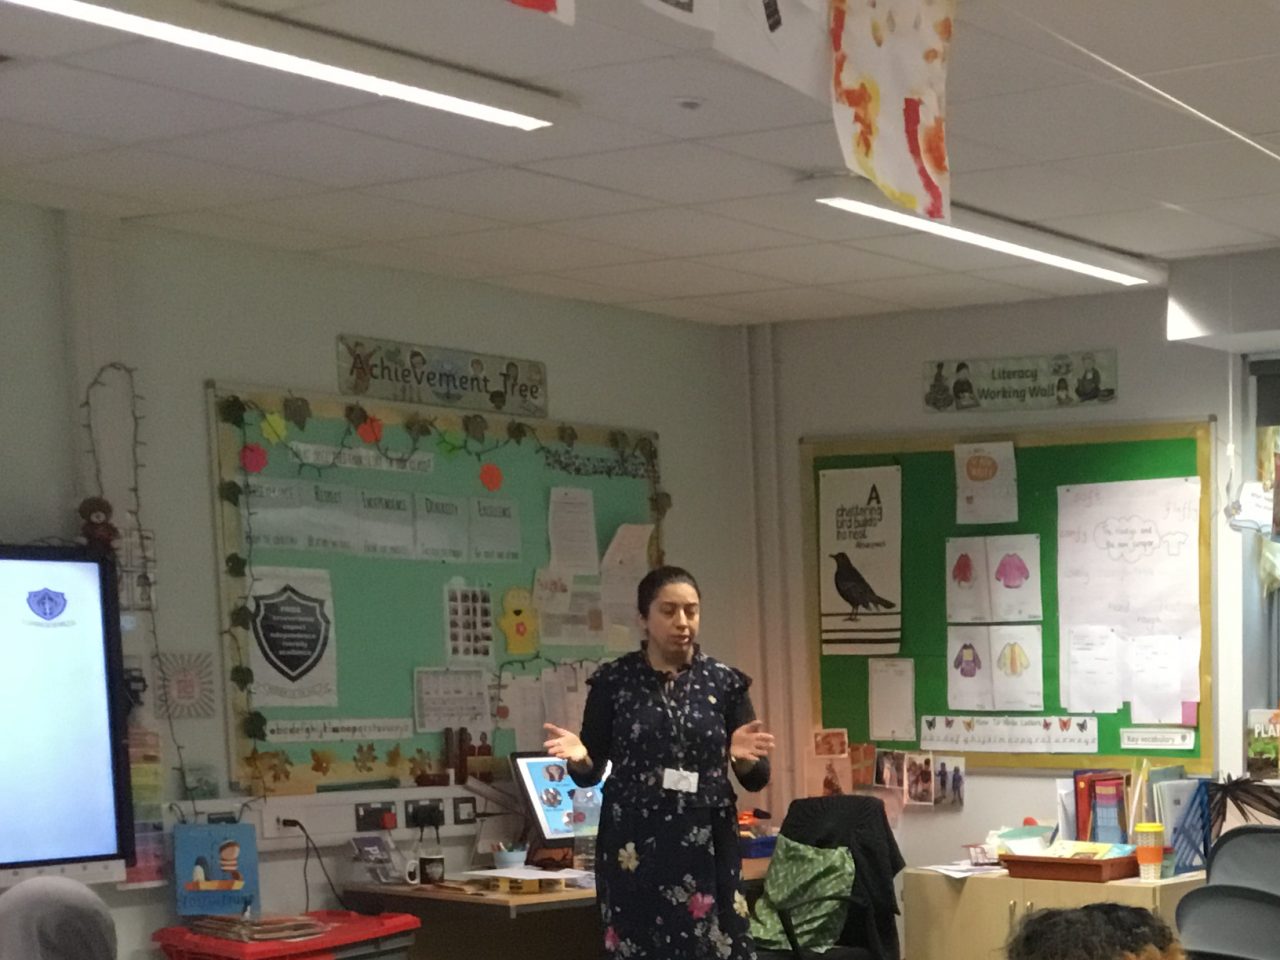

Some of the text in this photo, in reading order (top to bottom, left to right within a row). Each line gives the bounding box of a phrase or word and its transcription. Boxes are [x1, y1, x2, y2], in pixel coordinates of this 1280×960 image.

[350, 354, 540, 400] Achievement Tree
[991, 368, 1038, 382] Literacy
[977, 386, 1055, 401] Working Wall
[867, 484, 881, 505] A
[1140, 734, 1176, 744] vocabulary
